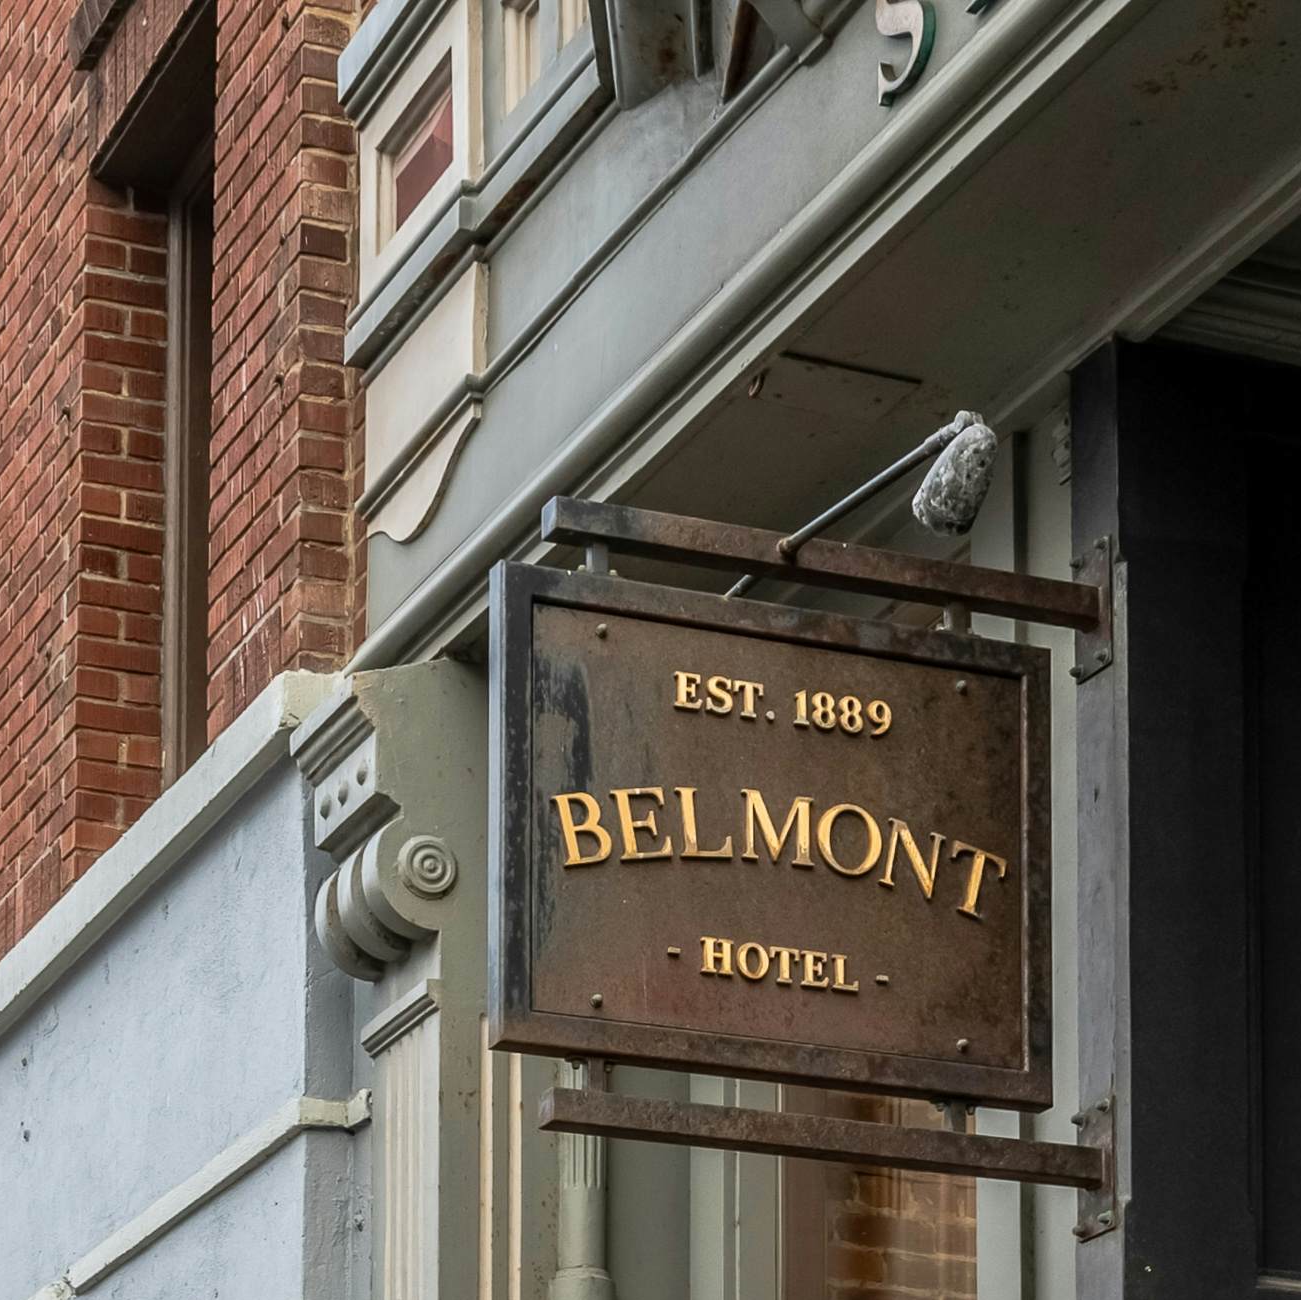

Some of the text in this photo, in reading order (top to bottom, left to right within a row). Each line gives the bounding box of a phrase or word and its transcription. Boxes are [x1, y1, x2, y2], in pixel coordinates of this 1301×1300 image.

[673, 670, 893, 738] EST. 1889
[551, 786, 1008, 921] BELMONT
[699, 935, 860, 993] HOTEL
